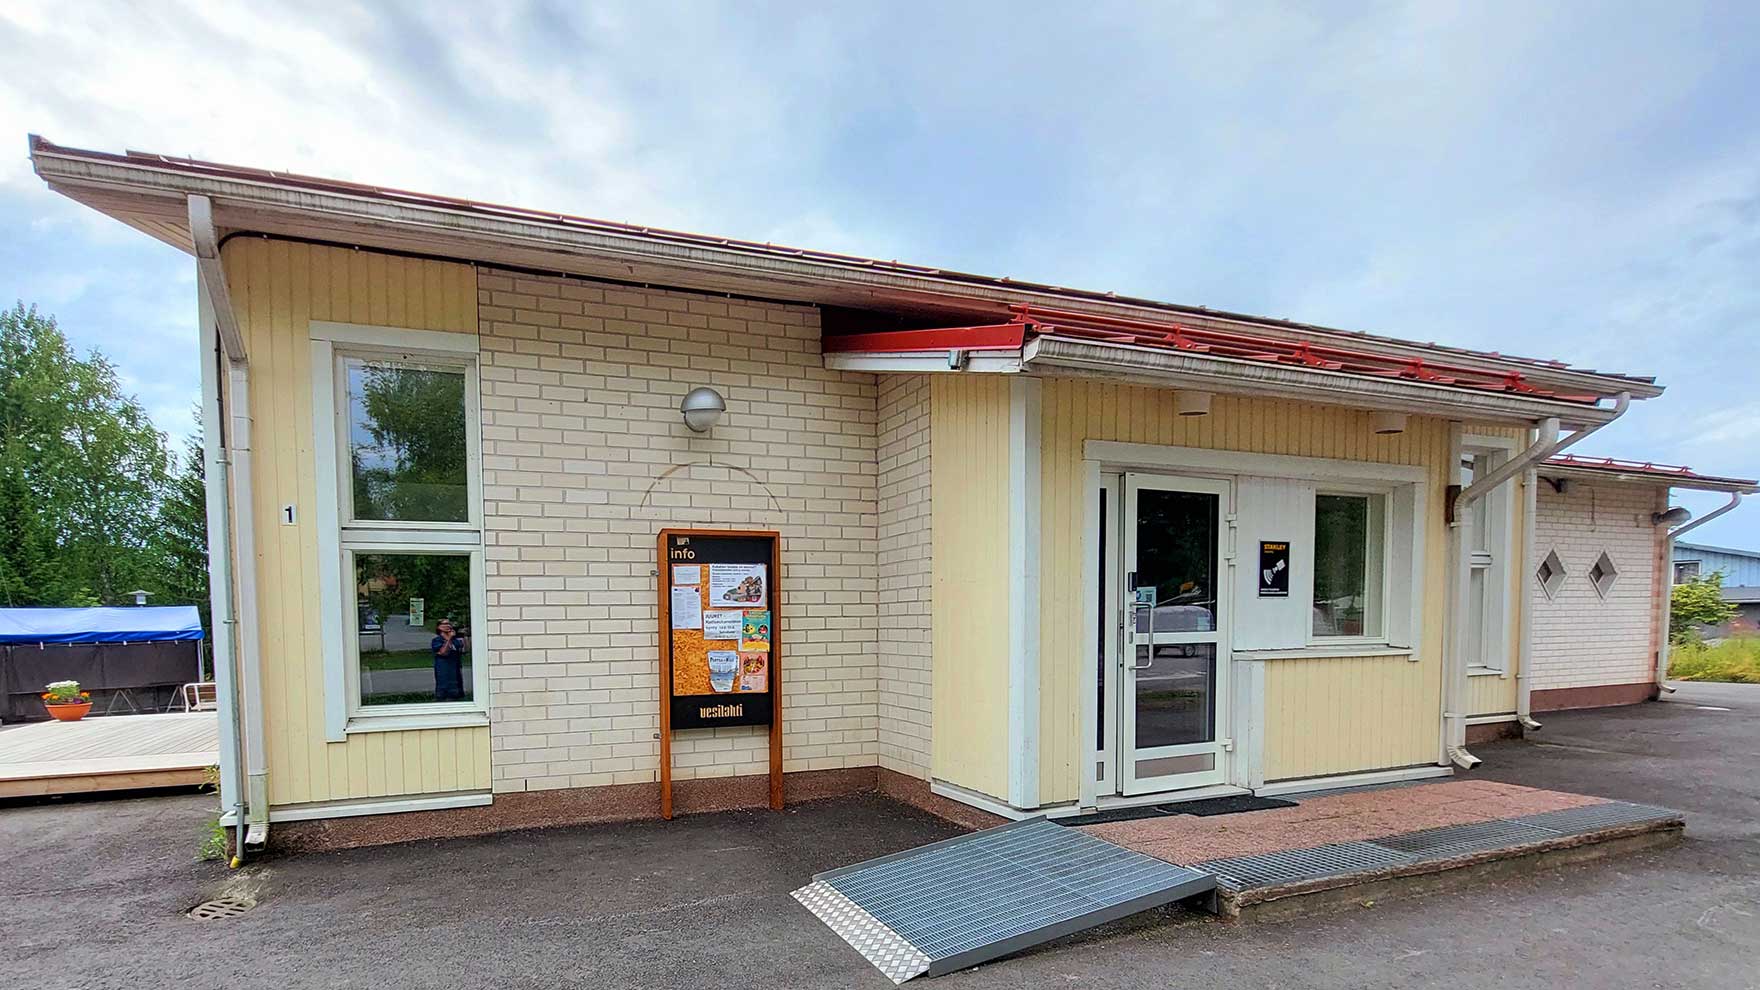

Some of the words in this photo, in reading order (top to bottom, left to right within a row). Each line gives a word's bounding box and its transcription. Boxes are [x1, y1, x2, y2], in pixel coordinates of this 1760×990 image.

[285, 506, 292, 523] 1
[671, 548, 695, 559] info
[700, 704, 743, 718] vesilahti
